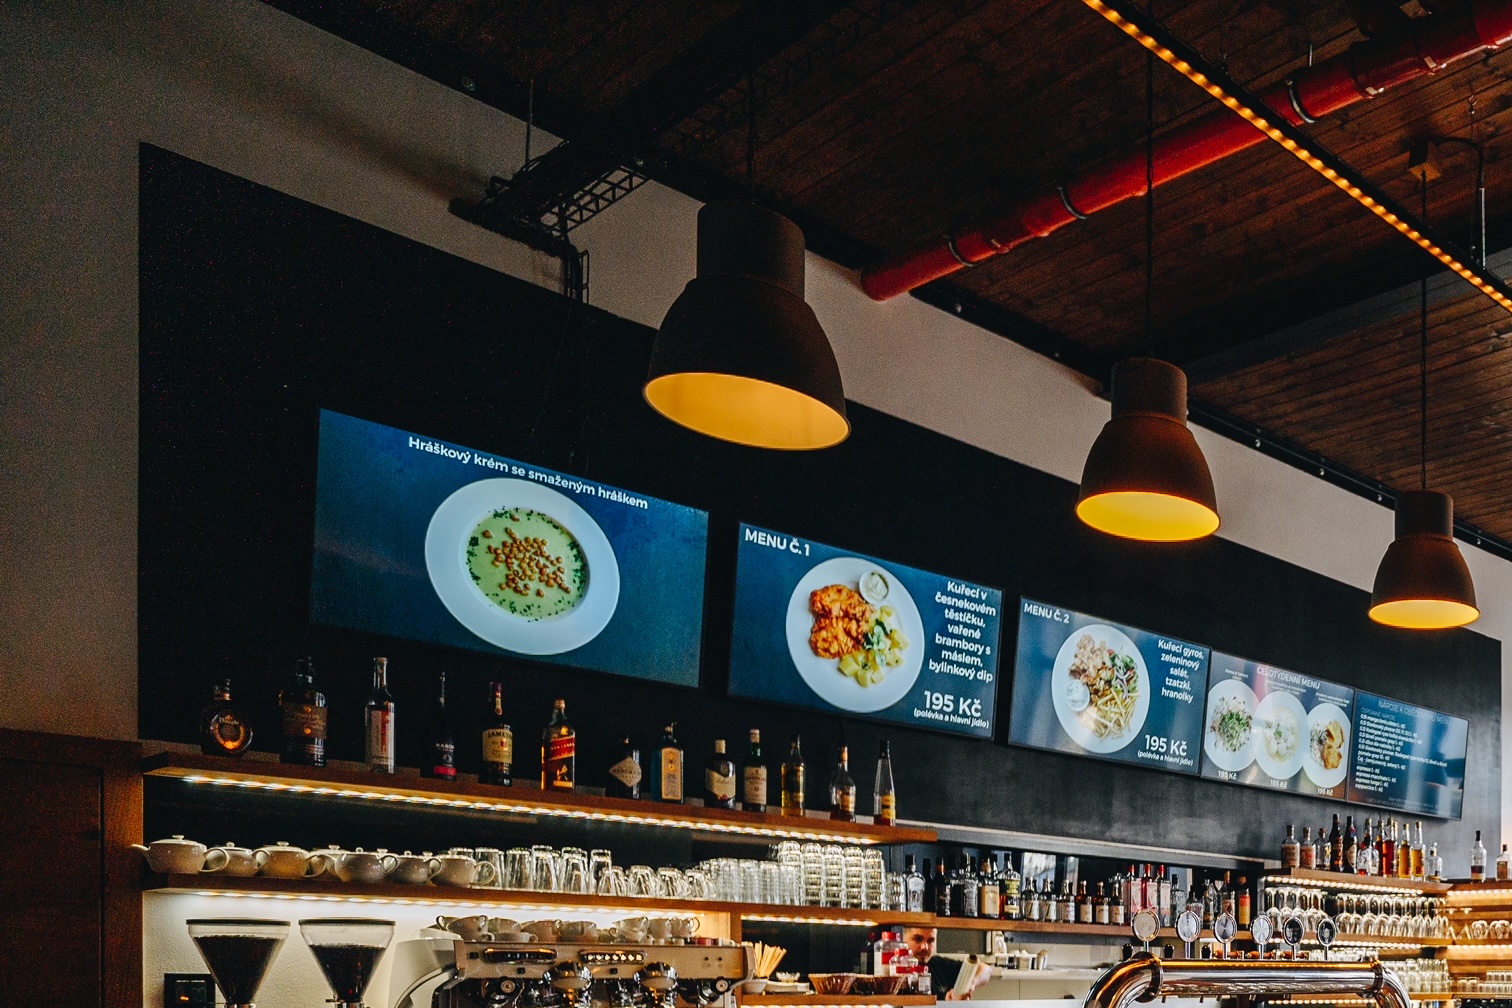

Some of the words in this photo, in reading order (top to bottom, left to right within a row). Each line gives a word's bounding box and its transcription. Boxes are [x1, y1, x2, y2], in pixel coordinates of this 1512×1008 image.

[408, 436, 471, 463] Hráškový
[474, 452, 508, 472] krém
[511, 465, 526, 477] se
[528, 468, 595, 496] smaženým
[598, 486, 648, 510] hráškem
[745, 528, 786, 550] MENU
[789, 537, 802, 555] Č.
[804, 543, 810, 556] 1
[947, 581, 980, 599] Kuřecí
[981, 592, 988, 600] v
[935, 591, 996, 616] česnekovém
[1024, 602, 1052, 619] MENU
[1053, 608, 1062, 622] Č.
[1063, 613, 1070, 624] 2
[944, 609, 986, 628] těstíčku,
[947, 624, 981, 640] vařené
[935, 635, 984, 656] brambory
[985, 646, 991, 655] s
[1158, 639, 1182, 654] Kuřecí
[1183, 646, 1205, 660] gyros,
[941, 650, 984, 668] máslem,
[1160, 653, 1200, 671] zeleninový
[929, 659, 976, 681] bylinkový
[976, 668, 993, 684] dip
[1302, 677, 1320, 690] MENU
[924, 690, 954, 712] 195
[958, 696, 982, 718] Kč
[1161, 688, 1194, 704] hranolky
[944, 714, 949, 722] a
[1145, 734, 1168, 752] 195
[1170, 740, 1188, 756] Kč
[1228, 771, 1237, 781] Kč
